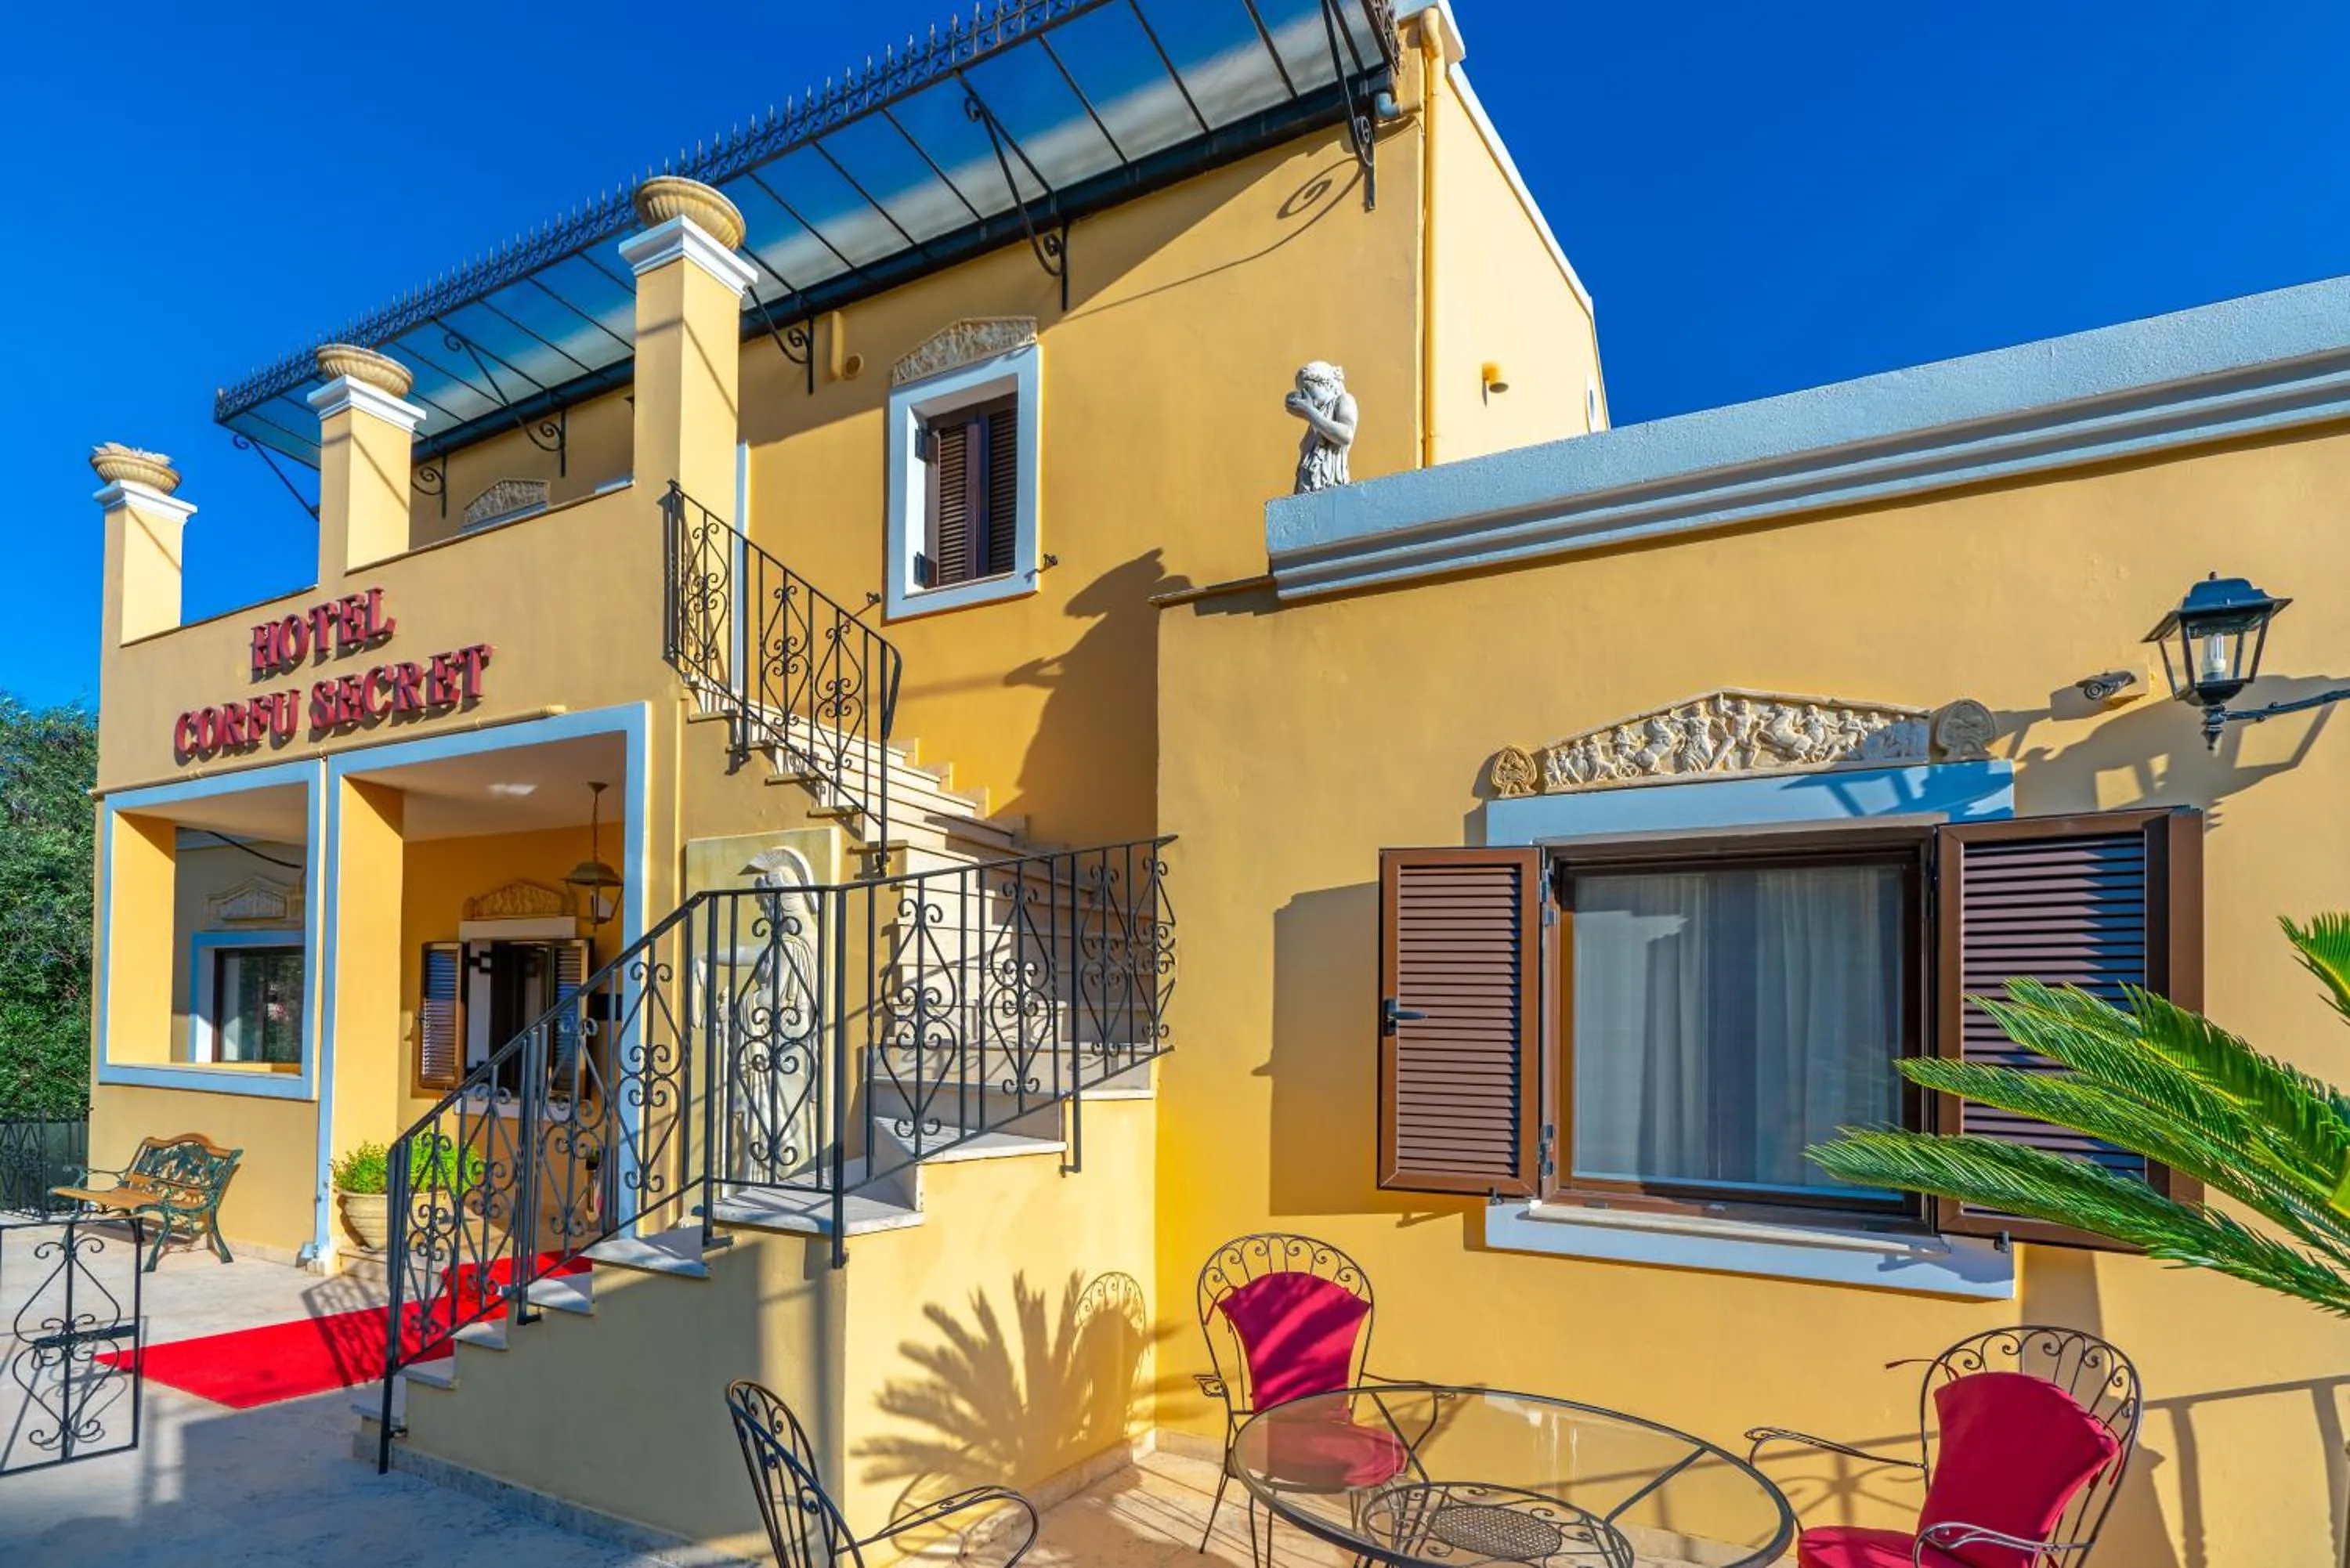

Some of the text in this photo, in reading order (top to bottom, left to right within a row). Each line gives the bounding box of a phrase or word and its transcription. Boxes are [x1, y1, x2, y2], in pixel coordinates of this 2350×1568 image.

[251, 587, 397, 671] HOTEL
[174, 644, 494, 753] CORFU SECRET
